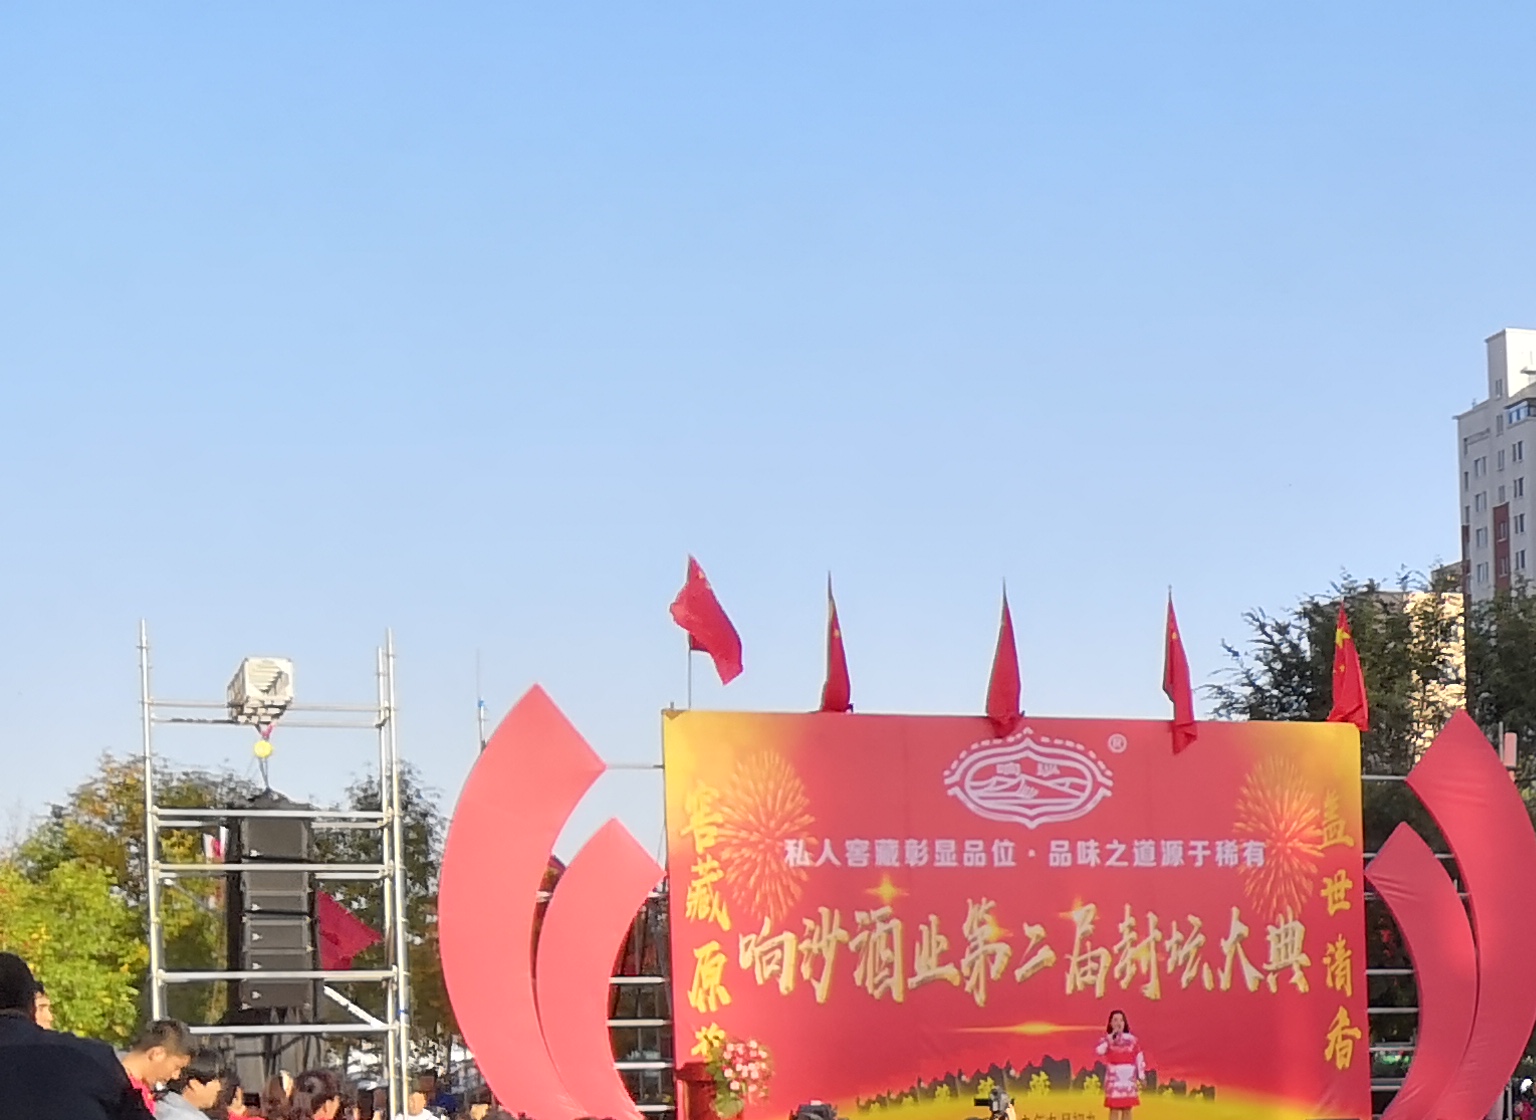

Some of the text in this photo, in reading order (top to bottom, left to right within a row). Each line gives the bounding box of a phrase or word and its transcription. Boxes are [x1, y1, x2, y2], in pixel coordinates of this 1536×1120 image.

[738, 896, 1312, 1008] 响沙酒业第二届封坛大典
